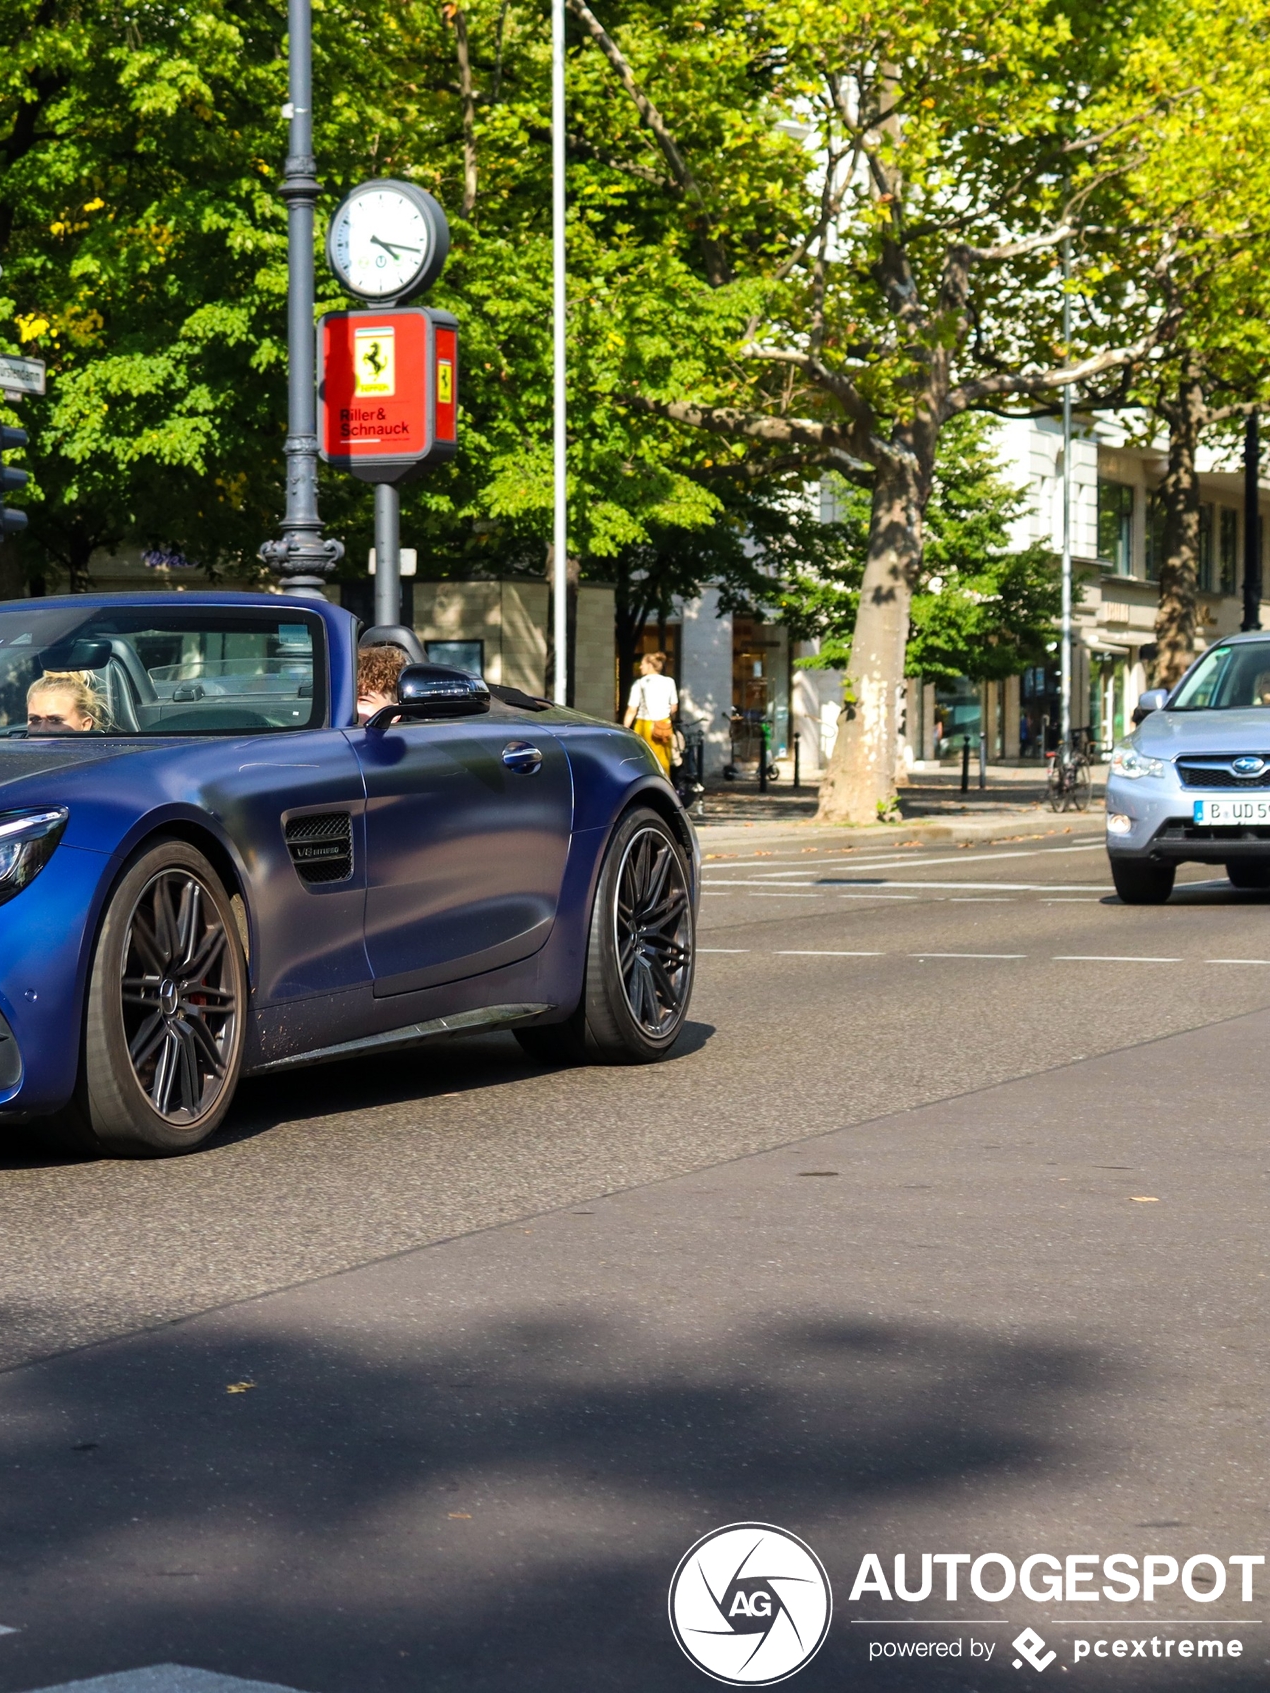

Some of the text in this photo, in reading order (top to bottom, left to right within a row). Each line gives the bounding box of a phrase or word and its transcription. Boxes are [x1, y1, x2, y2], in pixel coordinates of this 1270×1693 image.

[340, 421, 410, 437] Schnauck
[1211, 804, 1270, 818] B UD 5
